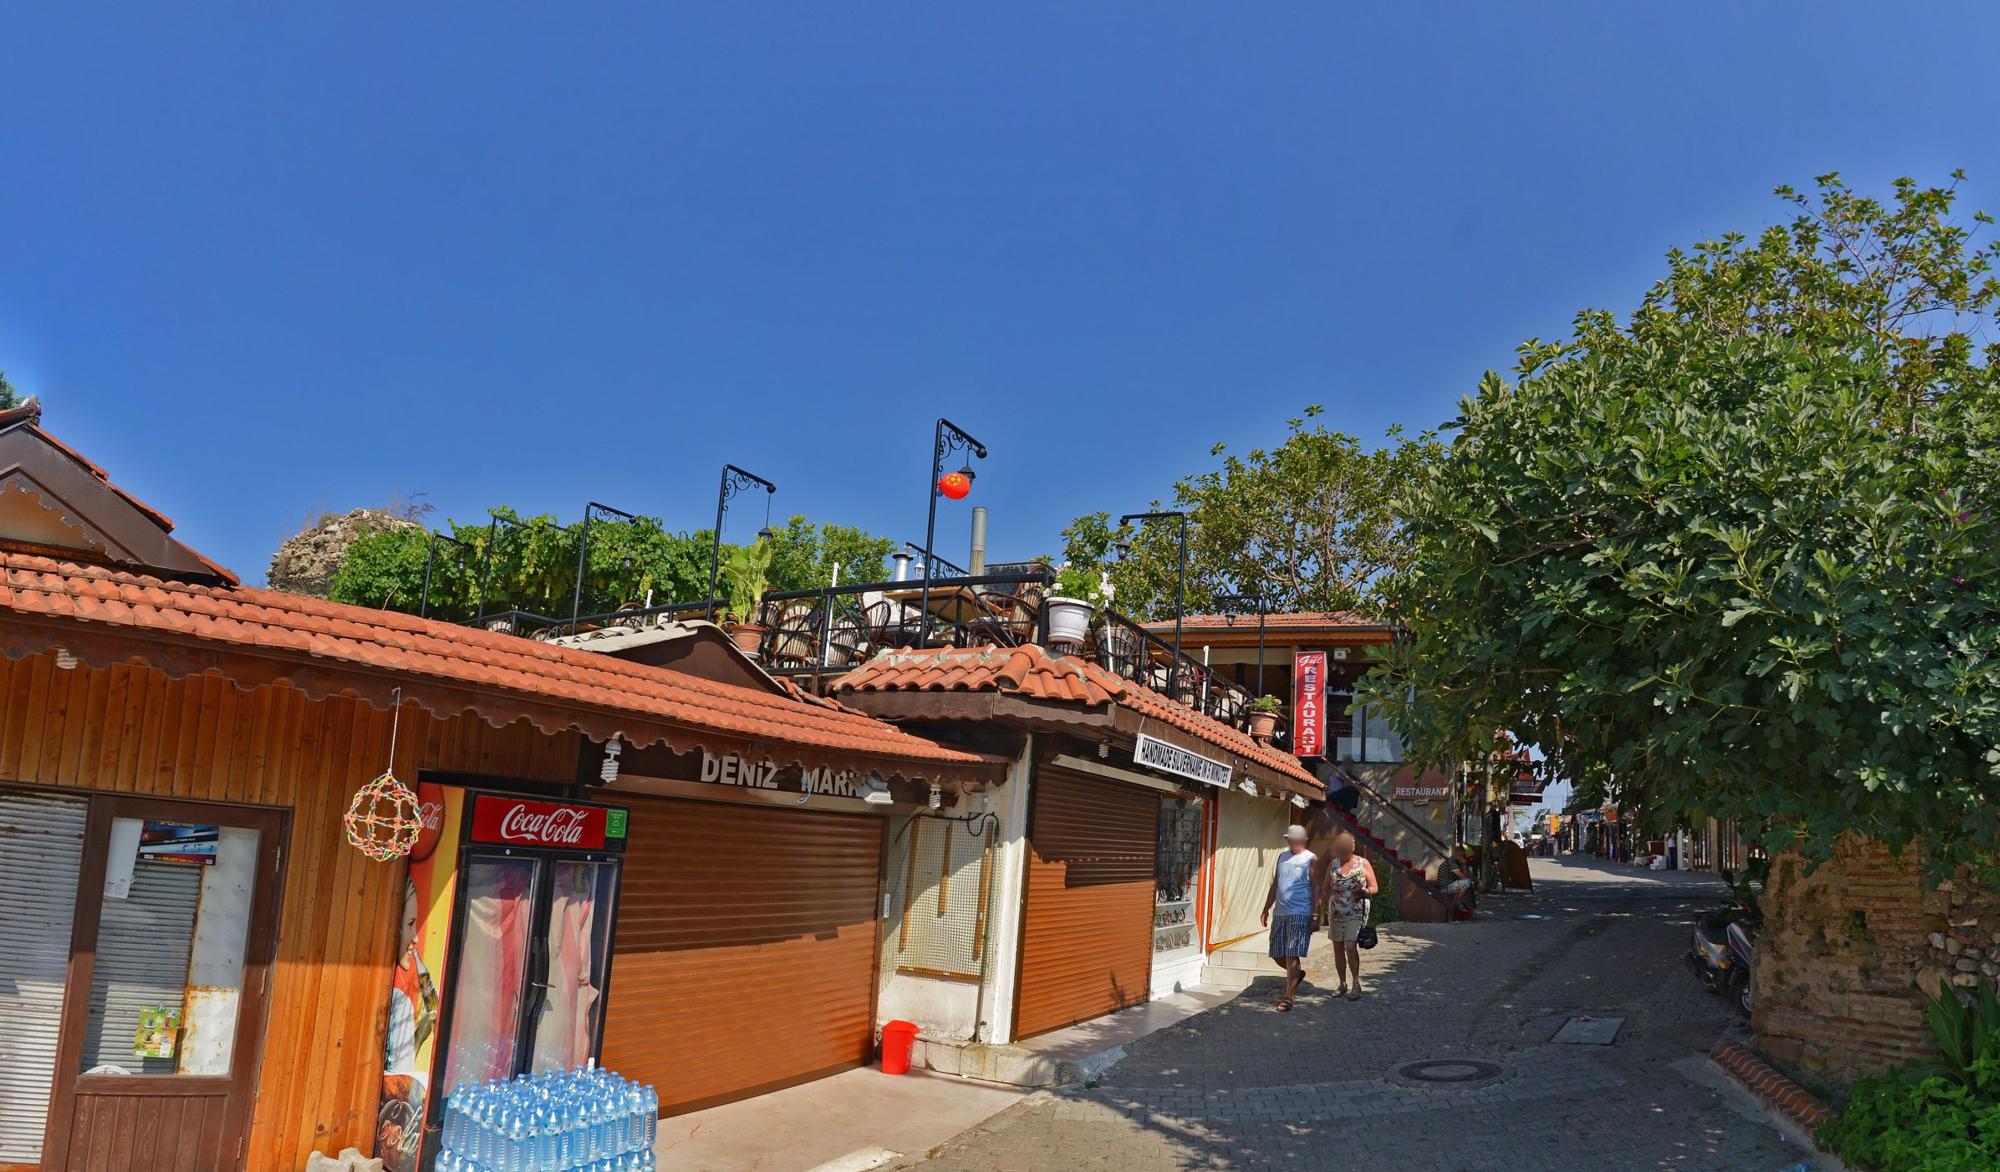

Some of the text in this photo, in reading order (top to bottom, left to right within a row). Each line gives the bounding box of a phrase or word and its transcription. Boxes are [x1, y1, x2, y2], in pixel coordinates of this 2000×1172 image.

[1299, 655, 1323, 667] Gül
[1302, 666, 1317, 753] RESTAURANT
[1395, 787, 1449, 797] RESTAURANT
[500, 803, 589, 844] Coca-Cola
